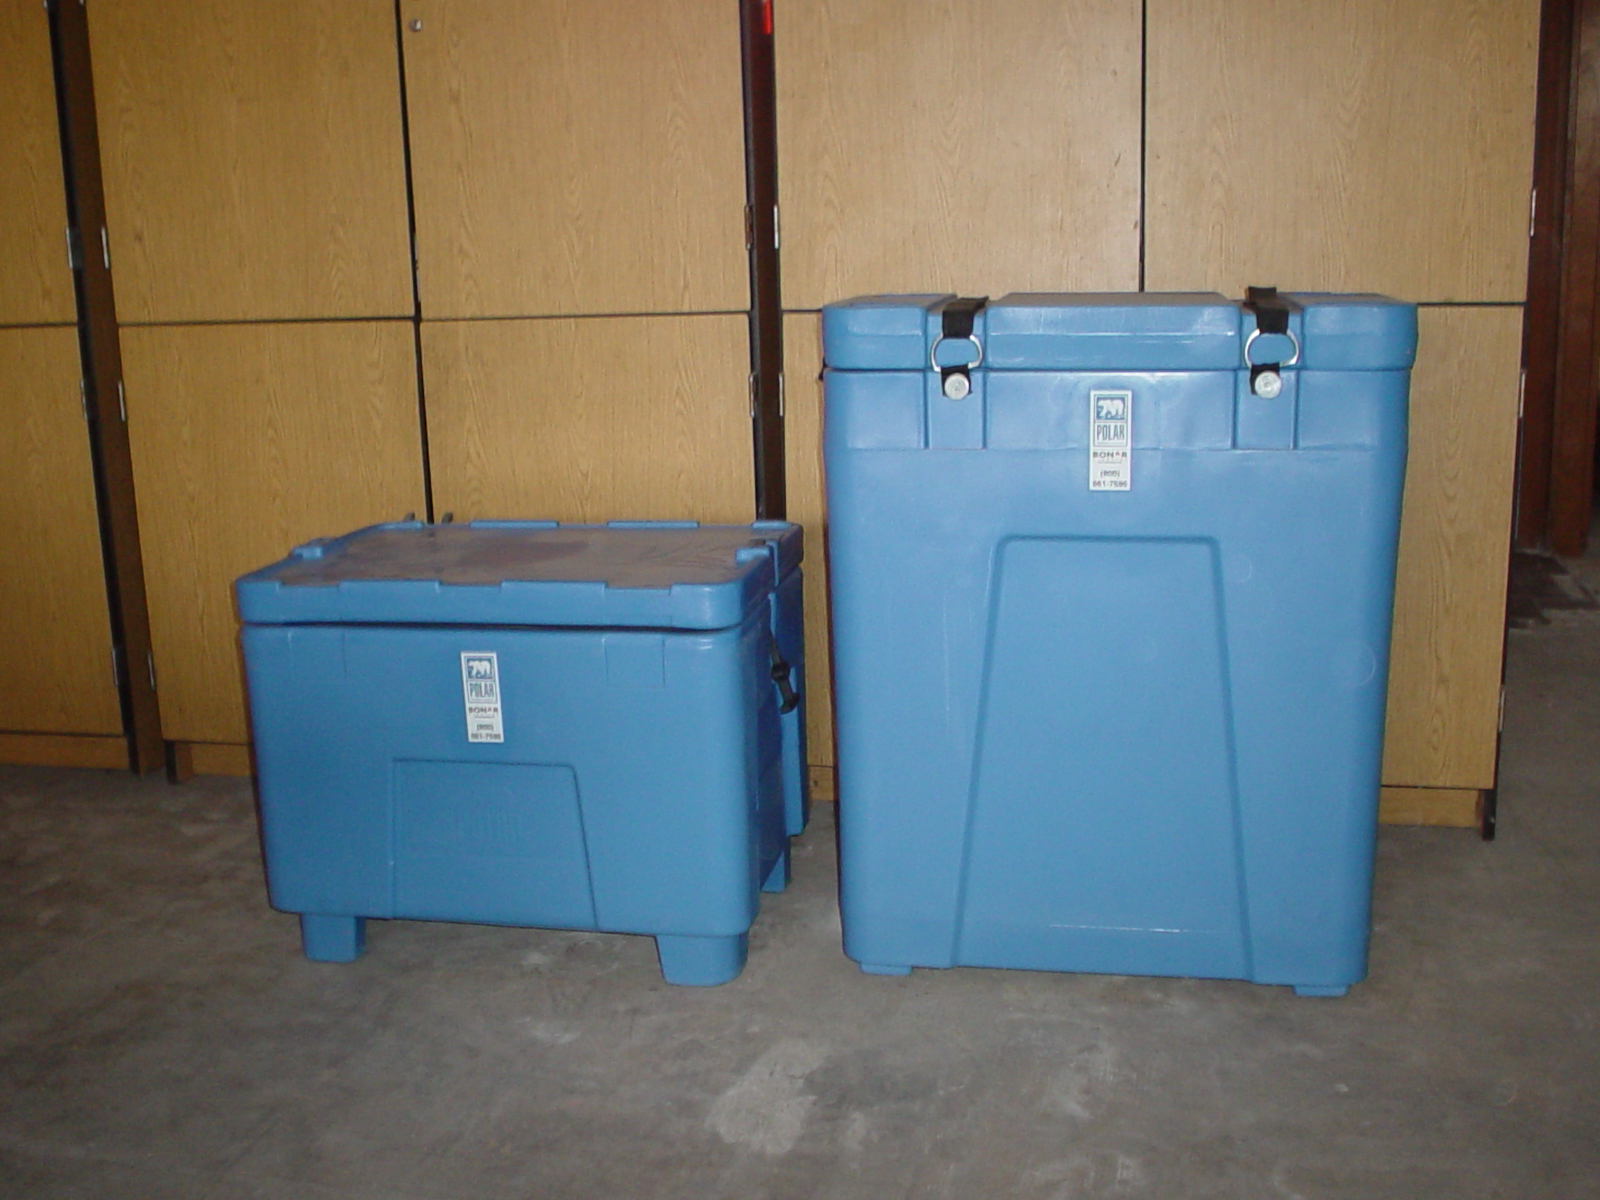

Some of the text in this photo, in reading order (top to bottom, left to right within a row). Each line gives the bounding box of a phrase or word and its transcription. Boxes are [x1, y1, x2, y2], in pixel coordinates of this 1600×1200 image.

[1097, 424, 1125, 441] POLAR
[1093, 451, 1127, 459] BONAR
[469, 683, 494, 698] POLAR
